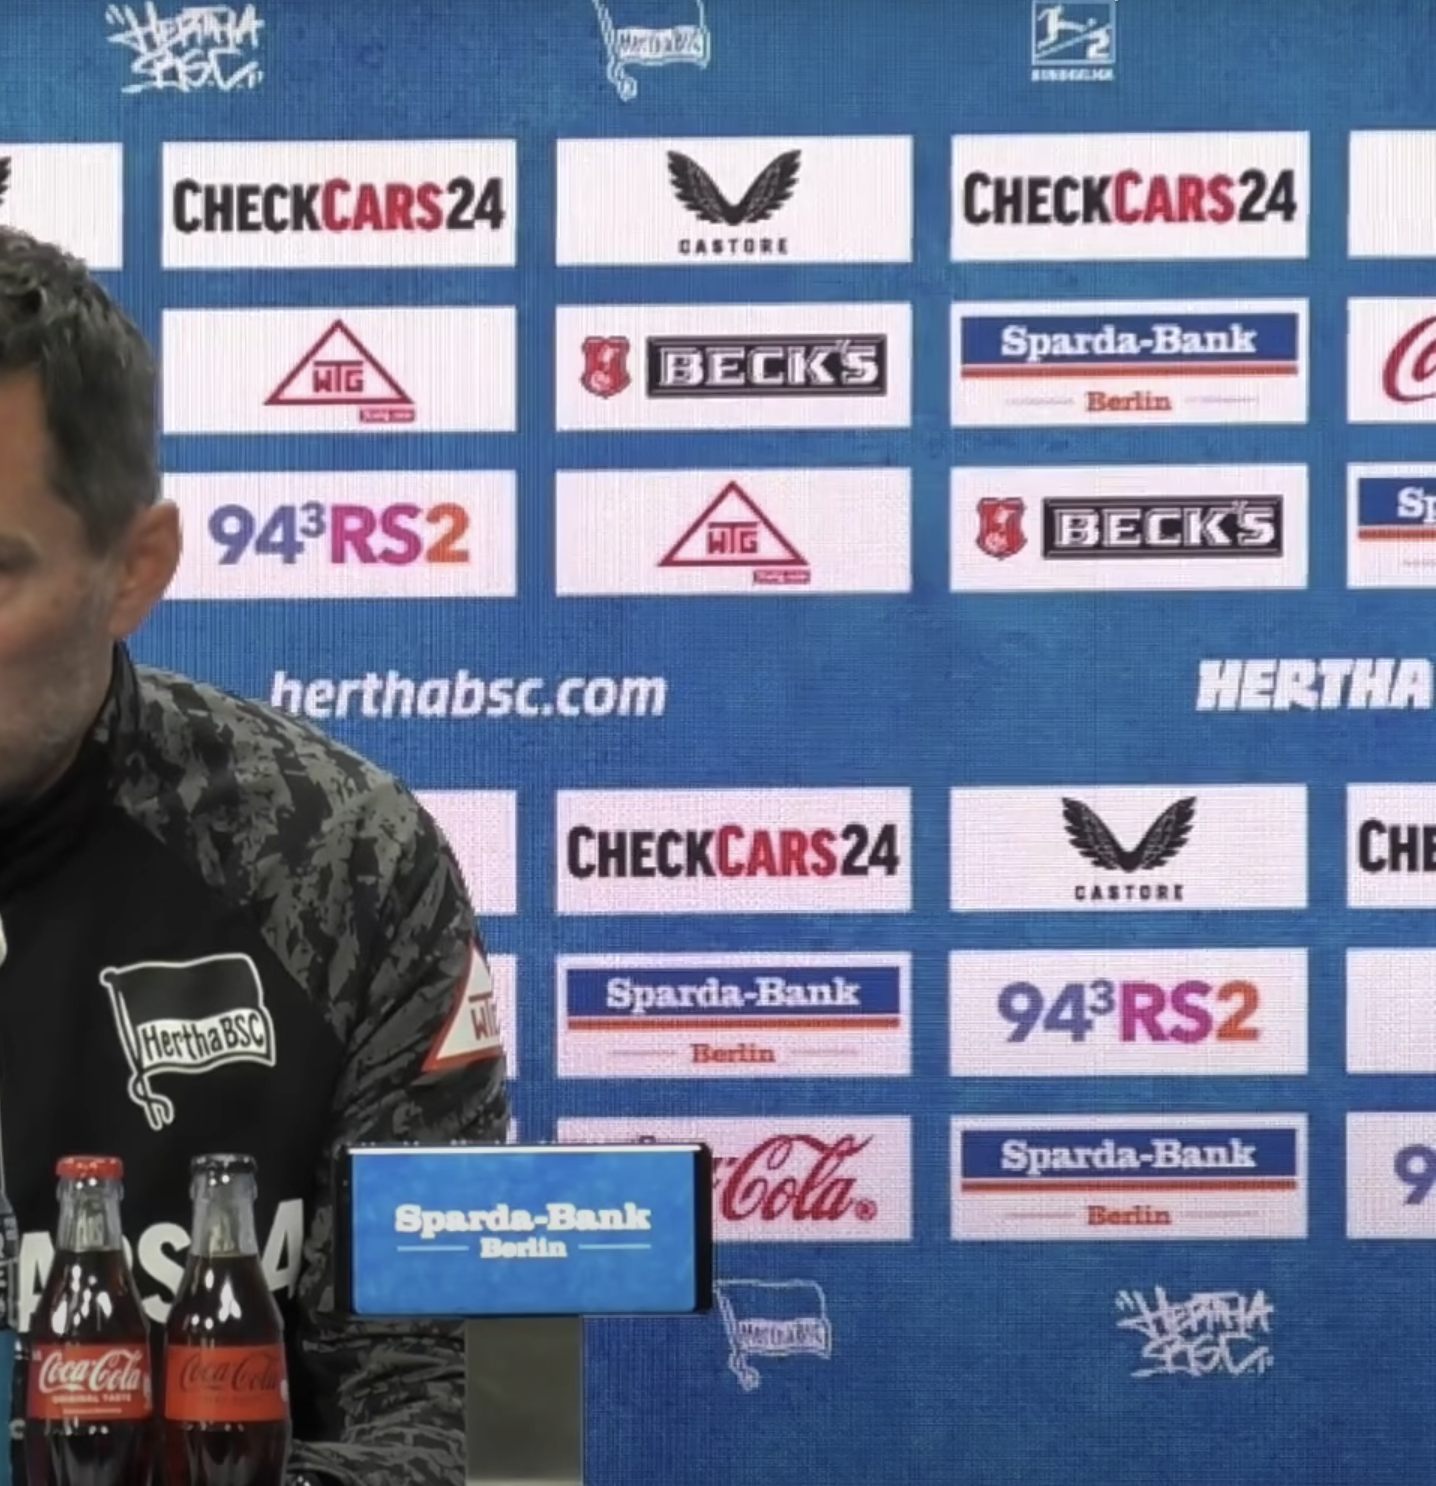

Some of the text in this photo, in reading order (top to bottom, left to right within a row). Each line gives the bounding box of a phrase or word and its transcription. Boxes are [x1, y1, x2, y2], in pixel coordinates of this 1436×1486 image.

[173, 177, 505, 234] CHECKCARS24
[964, 169, 1297, 225] CHECKCARS24
[679, 238, 786, 254] CASTORE
[1001, 323, 1257, 361] Sparda-Bank
[312, 360, 364, 394] WTG
[660, 342, 879, 387] BECK'S
[1087, 391, 1172, 412] Berlin
[1054, 500, 1276, 547] BECK'S
[264, 670, 667, 725] herthabsc.com
[1196, 658, 1433, 710] HERTHA
[568, 824, 899, 879] CHECKCARS24
[1075, 884, 1182, 900] CASTORE
[607, 975, 861, 1010] Sparda-Bank
[690, 1043, 776, 1063] Berlin
[1001, 1137, 1256, 1176] Sparda-Bank
[394, 1201, 652, 1238] Sparda-Bank
[1088, 1205, 1172, 1226] Berlin
[480, 1237, 567, 1258] Berlin
[39, 1349, 143, 1393] Coca-Cola
